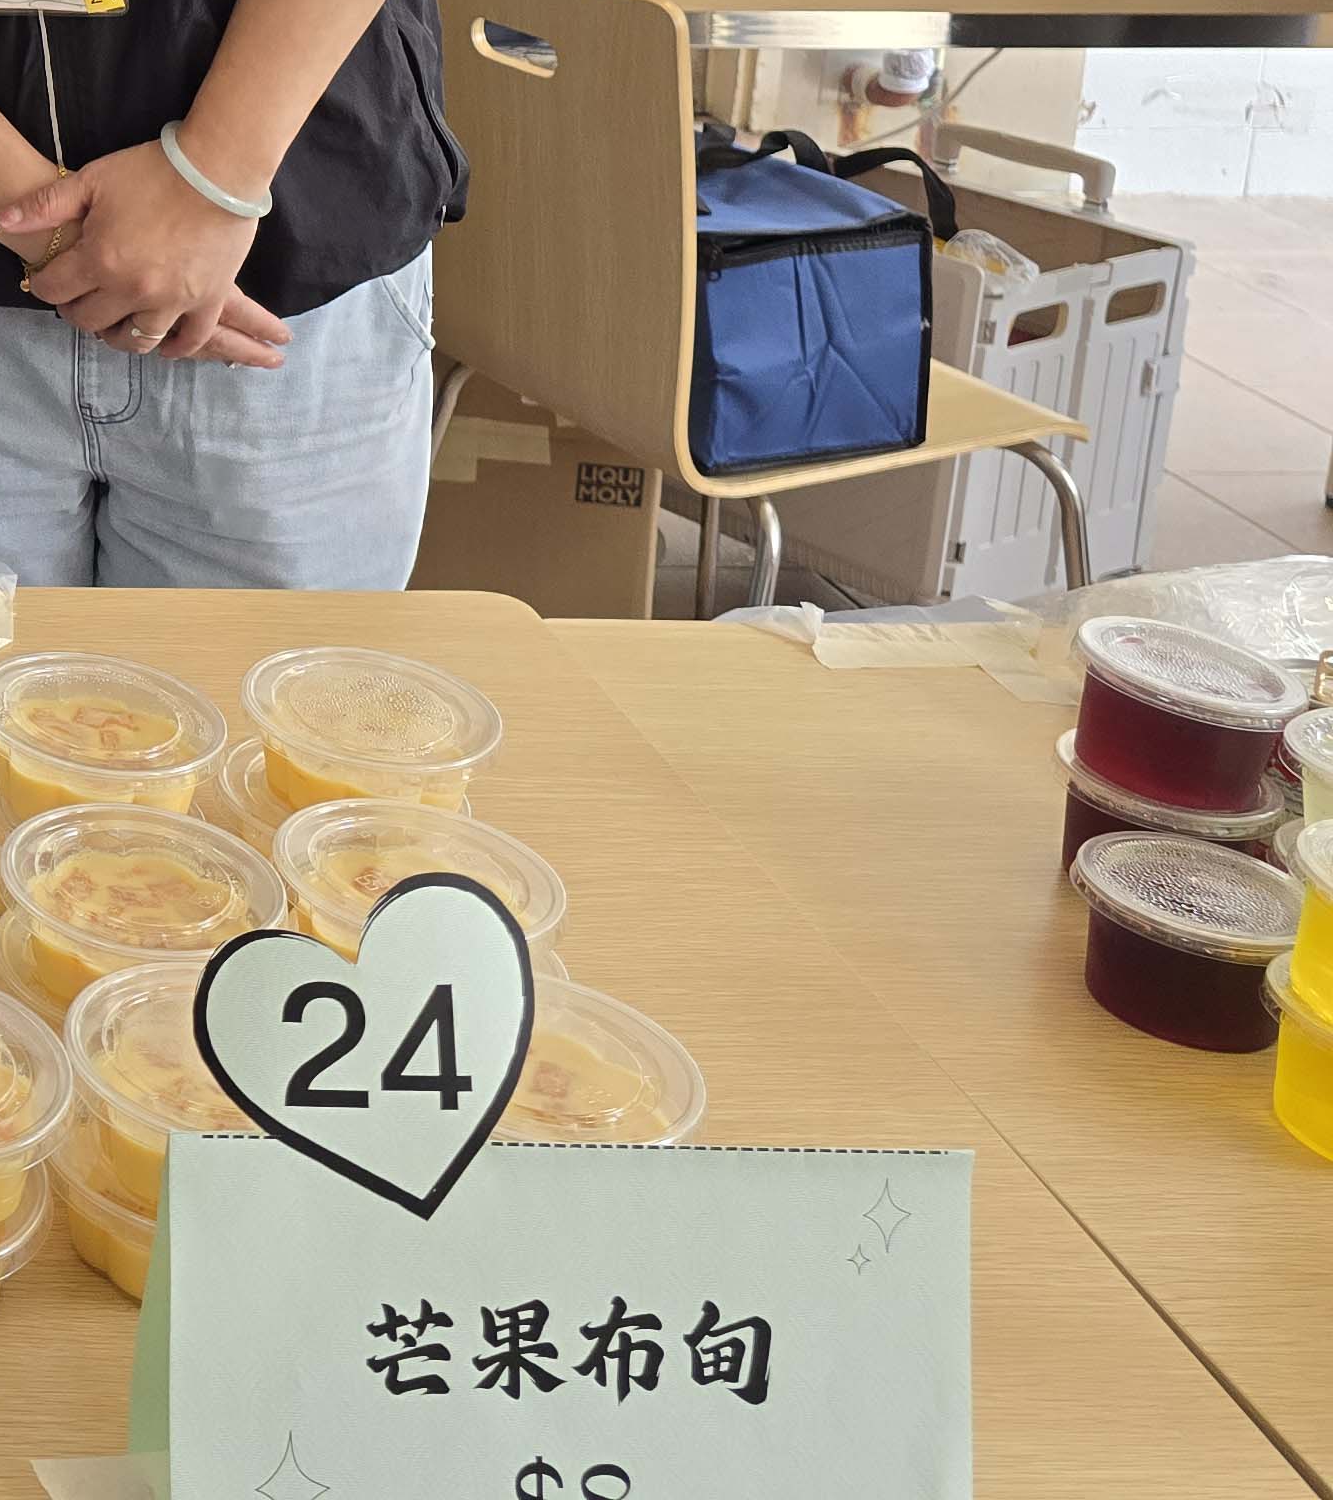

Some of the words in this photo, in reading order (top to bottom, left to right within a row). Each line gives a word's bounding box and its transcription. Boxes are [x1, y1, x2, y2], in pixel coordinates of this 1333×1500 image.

[577, 484, 641, 506] MOLY
[580, 465, 643, 489] LIQUI
[281, 980, 473, 1112] 24
[364, 1296, 775, 1405] 芒果布甸
